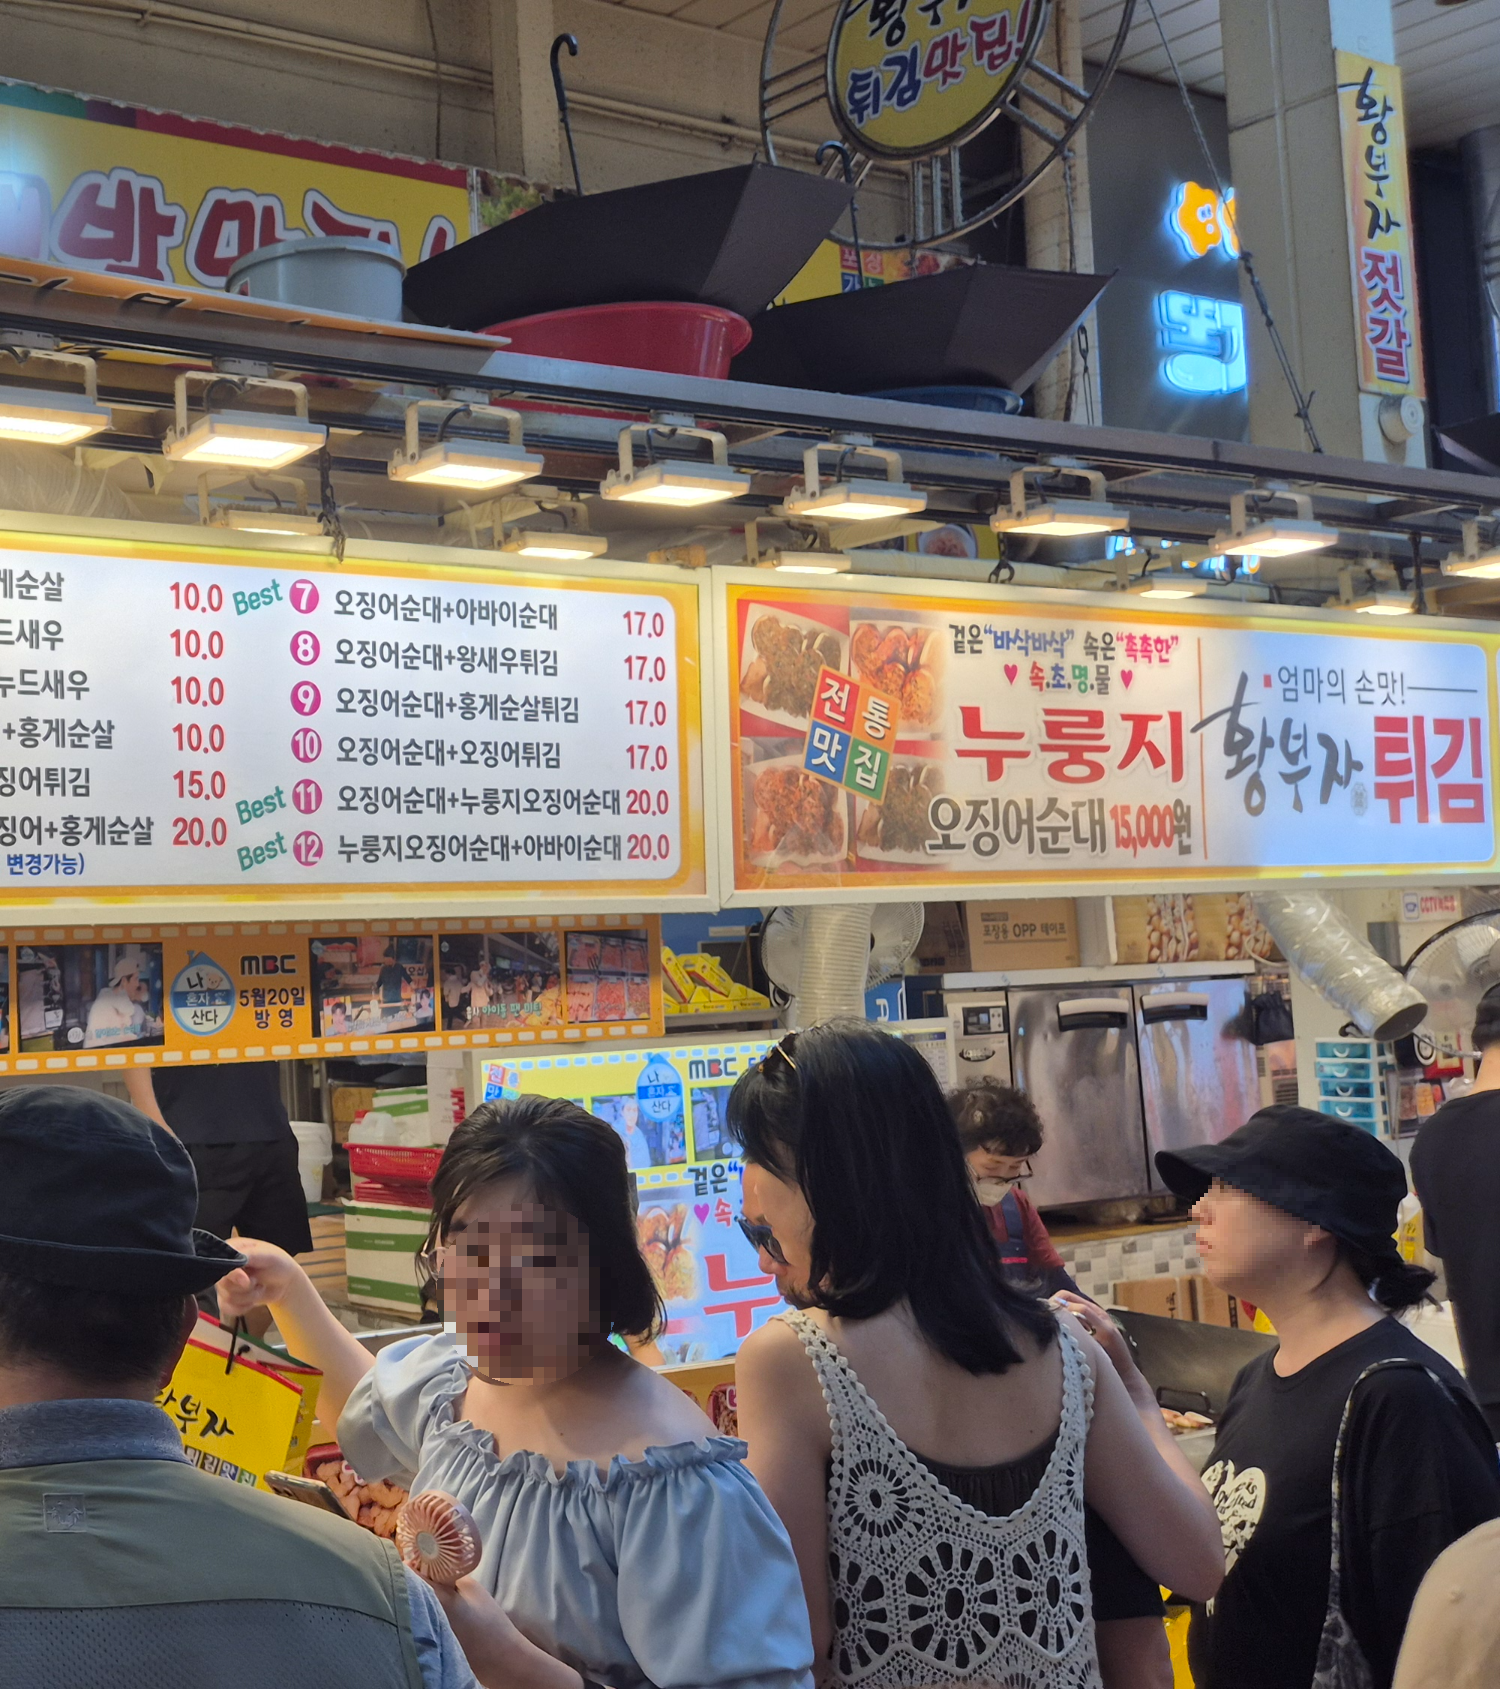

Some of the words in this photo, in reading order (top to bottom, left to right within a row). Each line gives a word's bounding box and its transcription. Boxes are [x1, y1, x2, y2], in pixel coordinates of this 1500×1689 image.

[1337, 67, 1401, 239] 황부자
[1363, 250, 1410, 380] 젓갈
[169, 582, 223, 612] 10.0
[233, 579, 283, 616] Best
[296, 583, 312, 610] 7
[334, 589, 558, 631] 오징어순대+아바이순대
[622, 611, 664, 638] 17.0
[170, 629, 224, 659] 10.0
[297, 634, 313, 662] 8
[335, 638, 558, 677] 오징어순대+왕새우튀김
[624, 655, 665, 683] 17.0
[171, 676, 224, 707] 10.0
[1277, 665, 1346, 703] 엄마의
[1354, 670, 1406, 706] 손맛!
[298, 685, 314, 712] 9
[335, 687, 579, 724] 오징어순대+홍게순살튀김
[625, 700, 666, 727] 17.0
[820, 677, 891, 740] 전통
[172, 723, 225, 754] 10.0
[294, 731, 319, 759] 10
[336, 736, 561, 770] 오징어순대+오징어튀김
[626, 745, 668, 772] 17.0
[954, 706, 1183, 783] 누룽지
[1190, 671, 1364, 817] 황부자
[1374, 715, 1485, 824] 튀김
[811, 727, 881, 791] 맛집
[172, 770, 226, 801] 15.0
[235, 786, 286, 825] Best
[295, 782, 318, 810] 11
[337, 784, 620, 817] 오징어순대+누룽지오징어순대
[625, 788, 669, 816] 20.0
[172, 817, 227, 848] 20.0
[928, 797, 1107, 857] 오징어순대
[6, 852, 86, 877] 변경가능)
[237, 832, 287, 871] Best
[297, 835, 321, 863] 12
[338, 834, 621, 863] 누룽지오징어순대+아바이순대
[627, 833, 670, 861] 20.0
[1013, 923, 1037, 938] OPP
[187, 972, 204, 989] 나
[241, 954, 296, 975] MBC
[186, 993, 210, 1006] 혼자
[240, 986, 305, 1007] 5월20일
[191, 1009, 218, 1025] 산다
[689, 1057, 738, 1080] MBC
